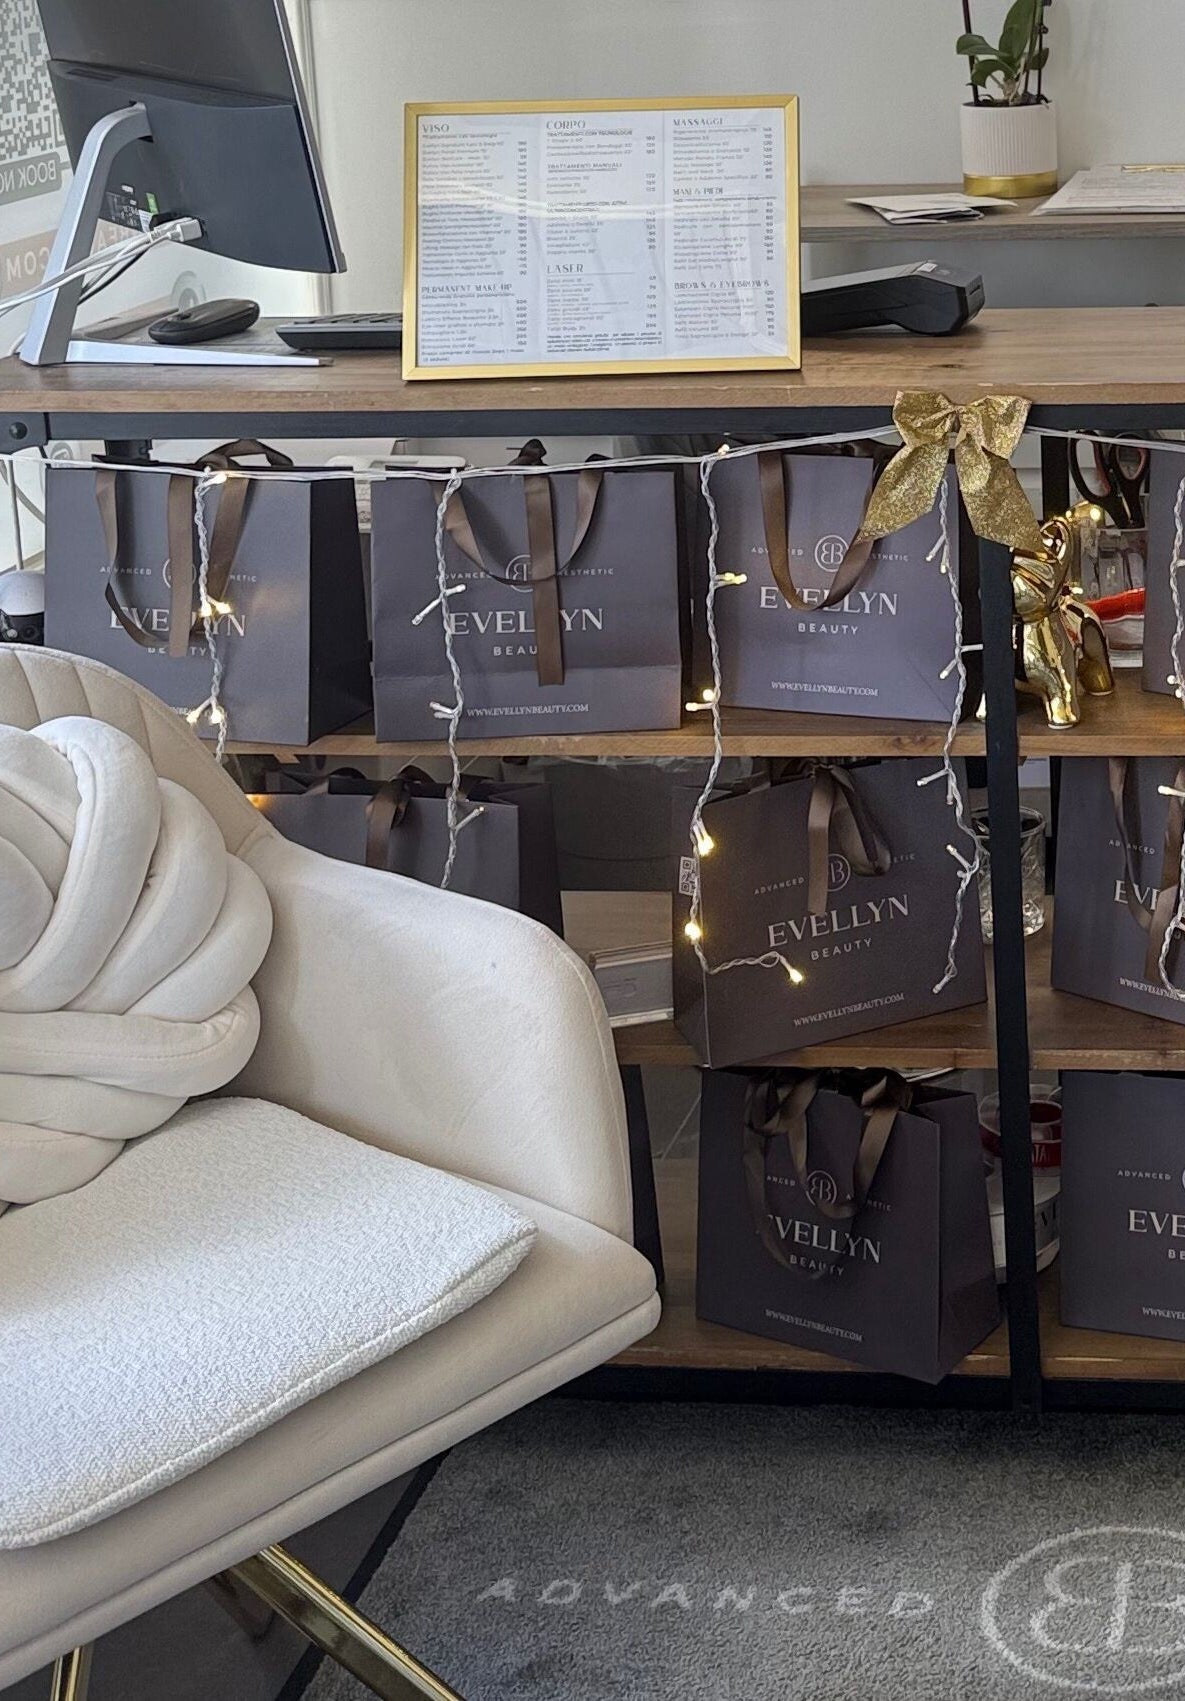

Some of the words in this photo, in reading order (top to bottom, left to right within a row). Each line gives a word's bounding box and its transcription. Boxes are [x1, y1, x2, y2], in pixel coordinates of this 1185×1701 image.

[421, 123, 450, 134] VISO
[545, 119, 586, 130] CORPO
[672, 117, 723, 127] MASSAGGI
[546, 263, 584, 274] LASER
[449, 608, 604, 636] EVELYN
[797, 622, 859, 636] BEAUTY
[493, 645, 539, 657] BEAU
[771, 681, 880, 697] WWW.EVELLYNBEAUTY.COM
[467, 702, 589, 718] WWW.EVELLYNBEAUTY.COM
[753, 876, 806, 896] ADVANCED
[767, 893, 910, 949] EVELLYN
[810, 937, 873, 962] BEAUTY
[792, 992, 906, 1029] WWW.EVELLYNBEAUTY.COM
[1117, 1169, 1172, 1181] ADVANCED
[756, 1213, 882, 1264] VELLYN
[789, 1253, 845, 1277] BEAUTY
[477, 1576, 936, 1619] ADVANCED
